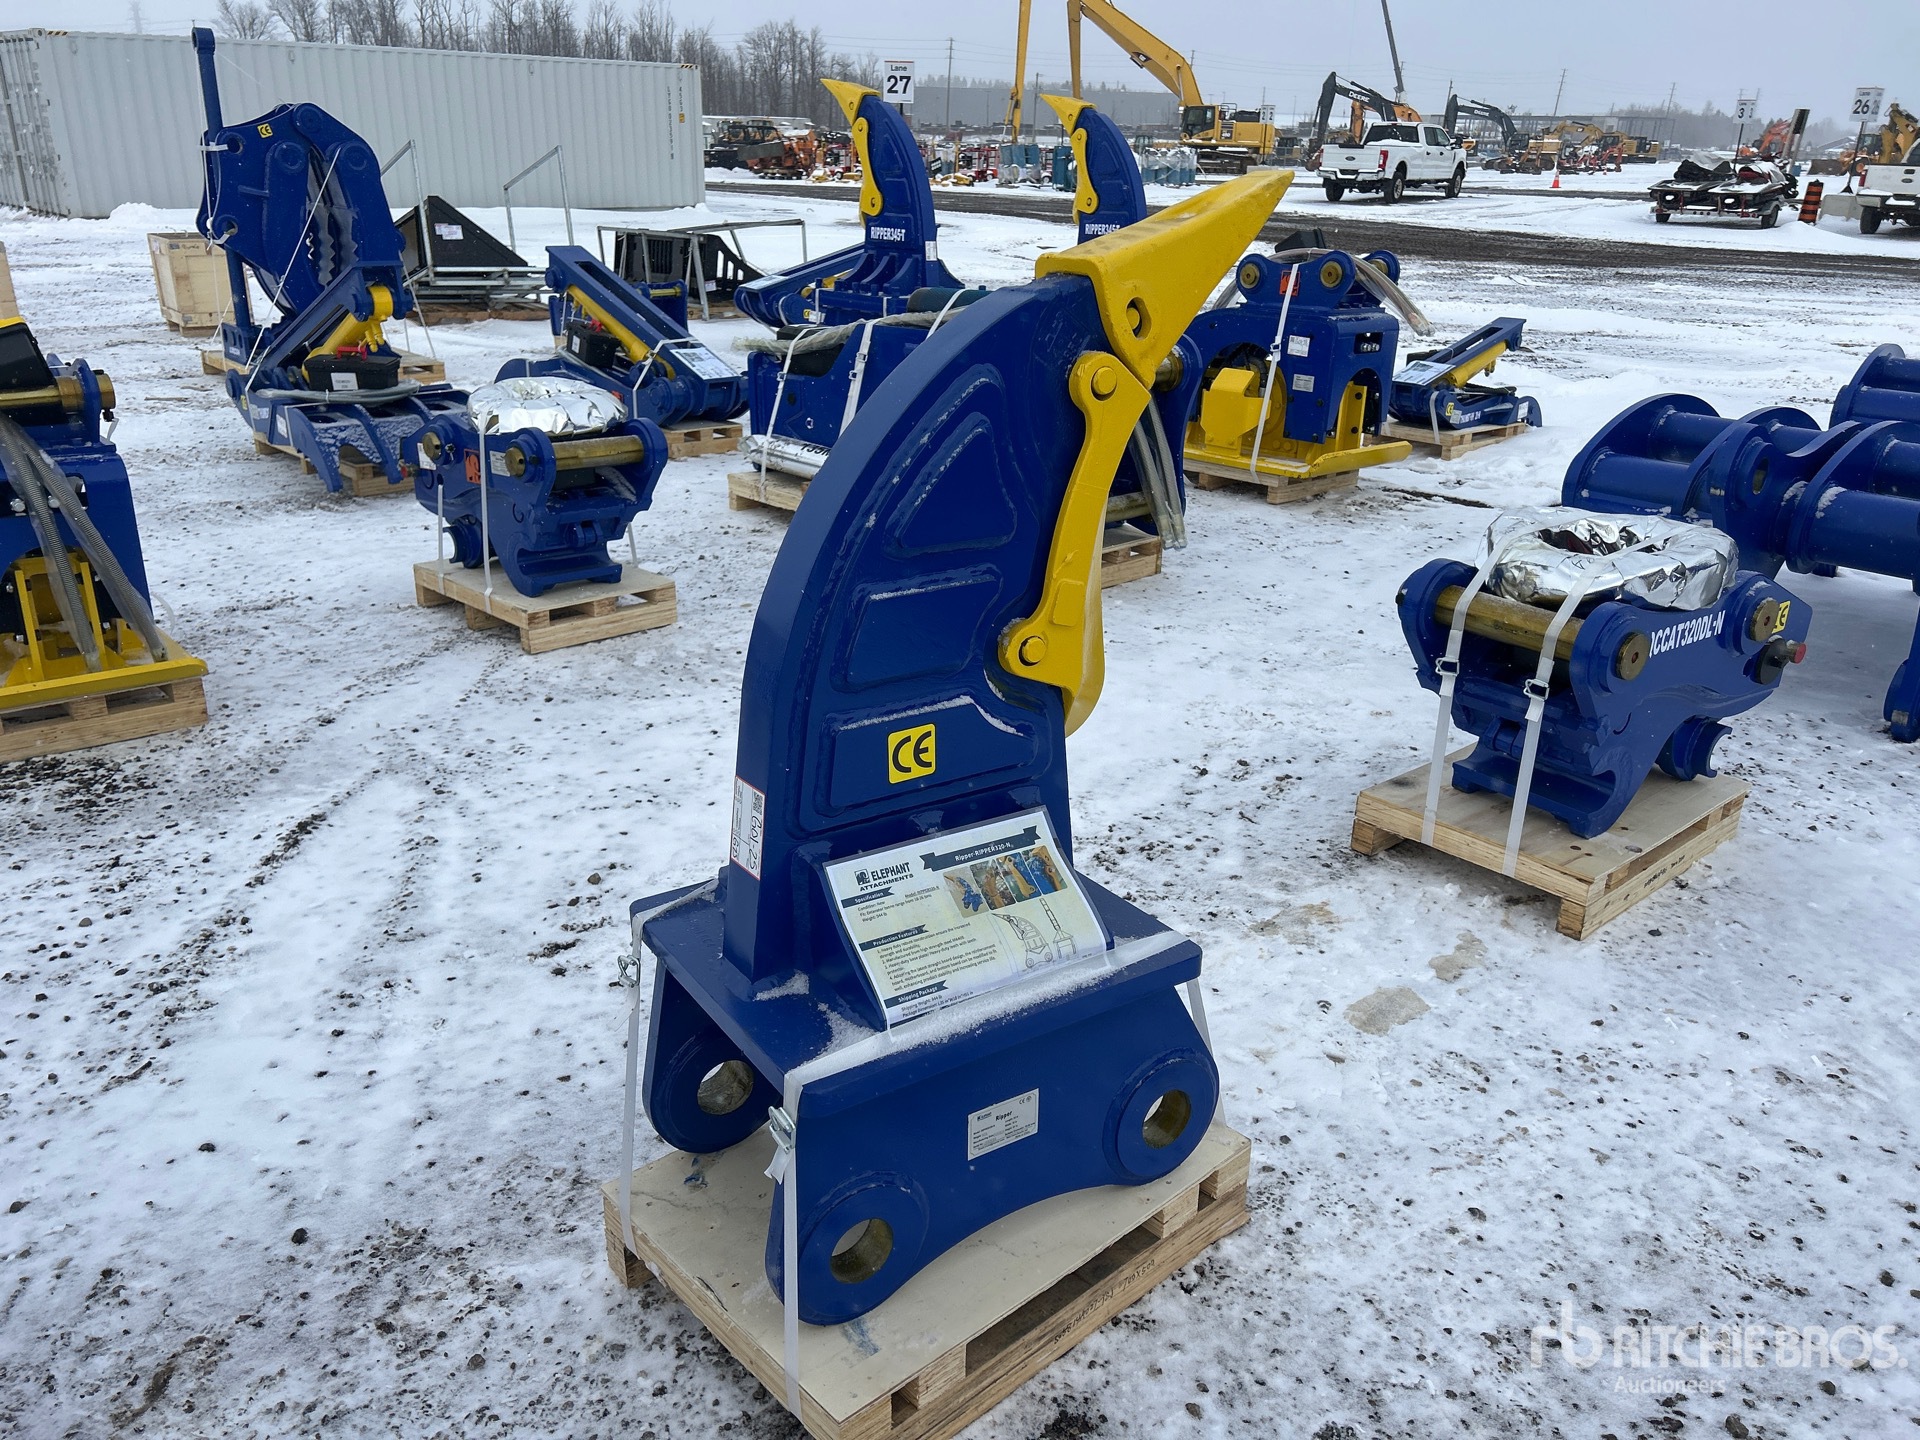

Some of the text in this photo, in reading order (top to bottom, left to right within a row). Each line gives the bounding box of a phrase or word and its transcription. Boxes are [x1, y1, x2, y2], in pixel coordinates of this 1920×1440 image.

[886, 74, 912, 94] 27
[1348, 92, 1371, 103] DEERE
[1852, 98, 1870, 114] 26
[870, 226, 906, 242] RIPPER345-T
[892, 730, 932, 773] CE
[871, 862, 910, 882] ELEPHANT
[860, 874, 914, 891] ATTACHMENTS
[873, 929, 918, 946] Production Features
[898, 985, 938, 1003] Shipping Package
[996, 1111, 1012, 1121] Ripper
